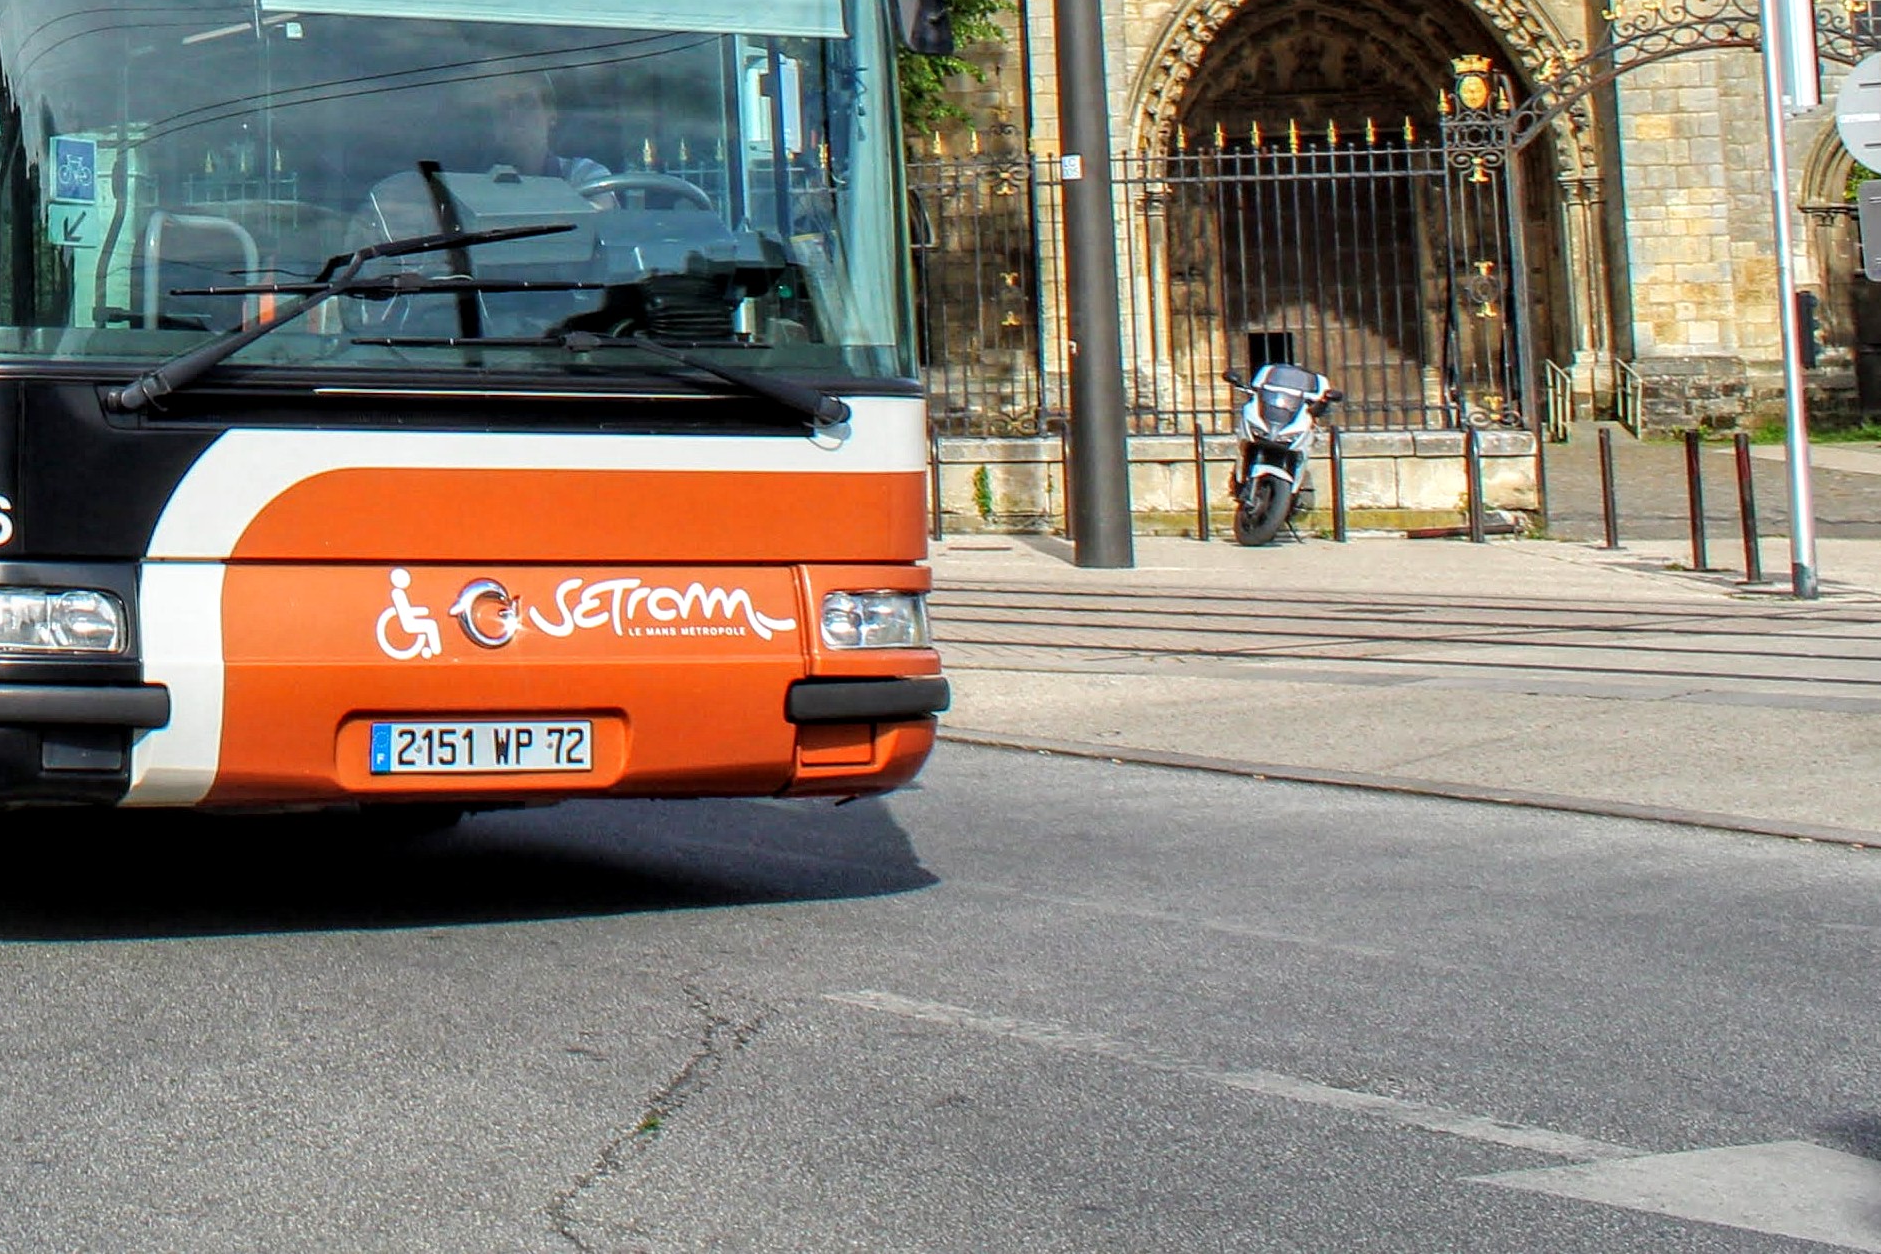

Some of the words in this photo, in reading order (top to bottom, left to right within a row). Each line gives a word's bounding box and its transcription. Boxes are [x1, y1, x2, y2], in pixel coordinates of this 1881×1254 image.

[628, 627, 642, 636] LE
[645, 627, 677, 636] MANS
[377, 754, 384, 765] F
[397, 729, 475, 766] 2151
[494, 728, 533, 765] WP
[551, 727, 585, 764] 72
